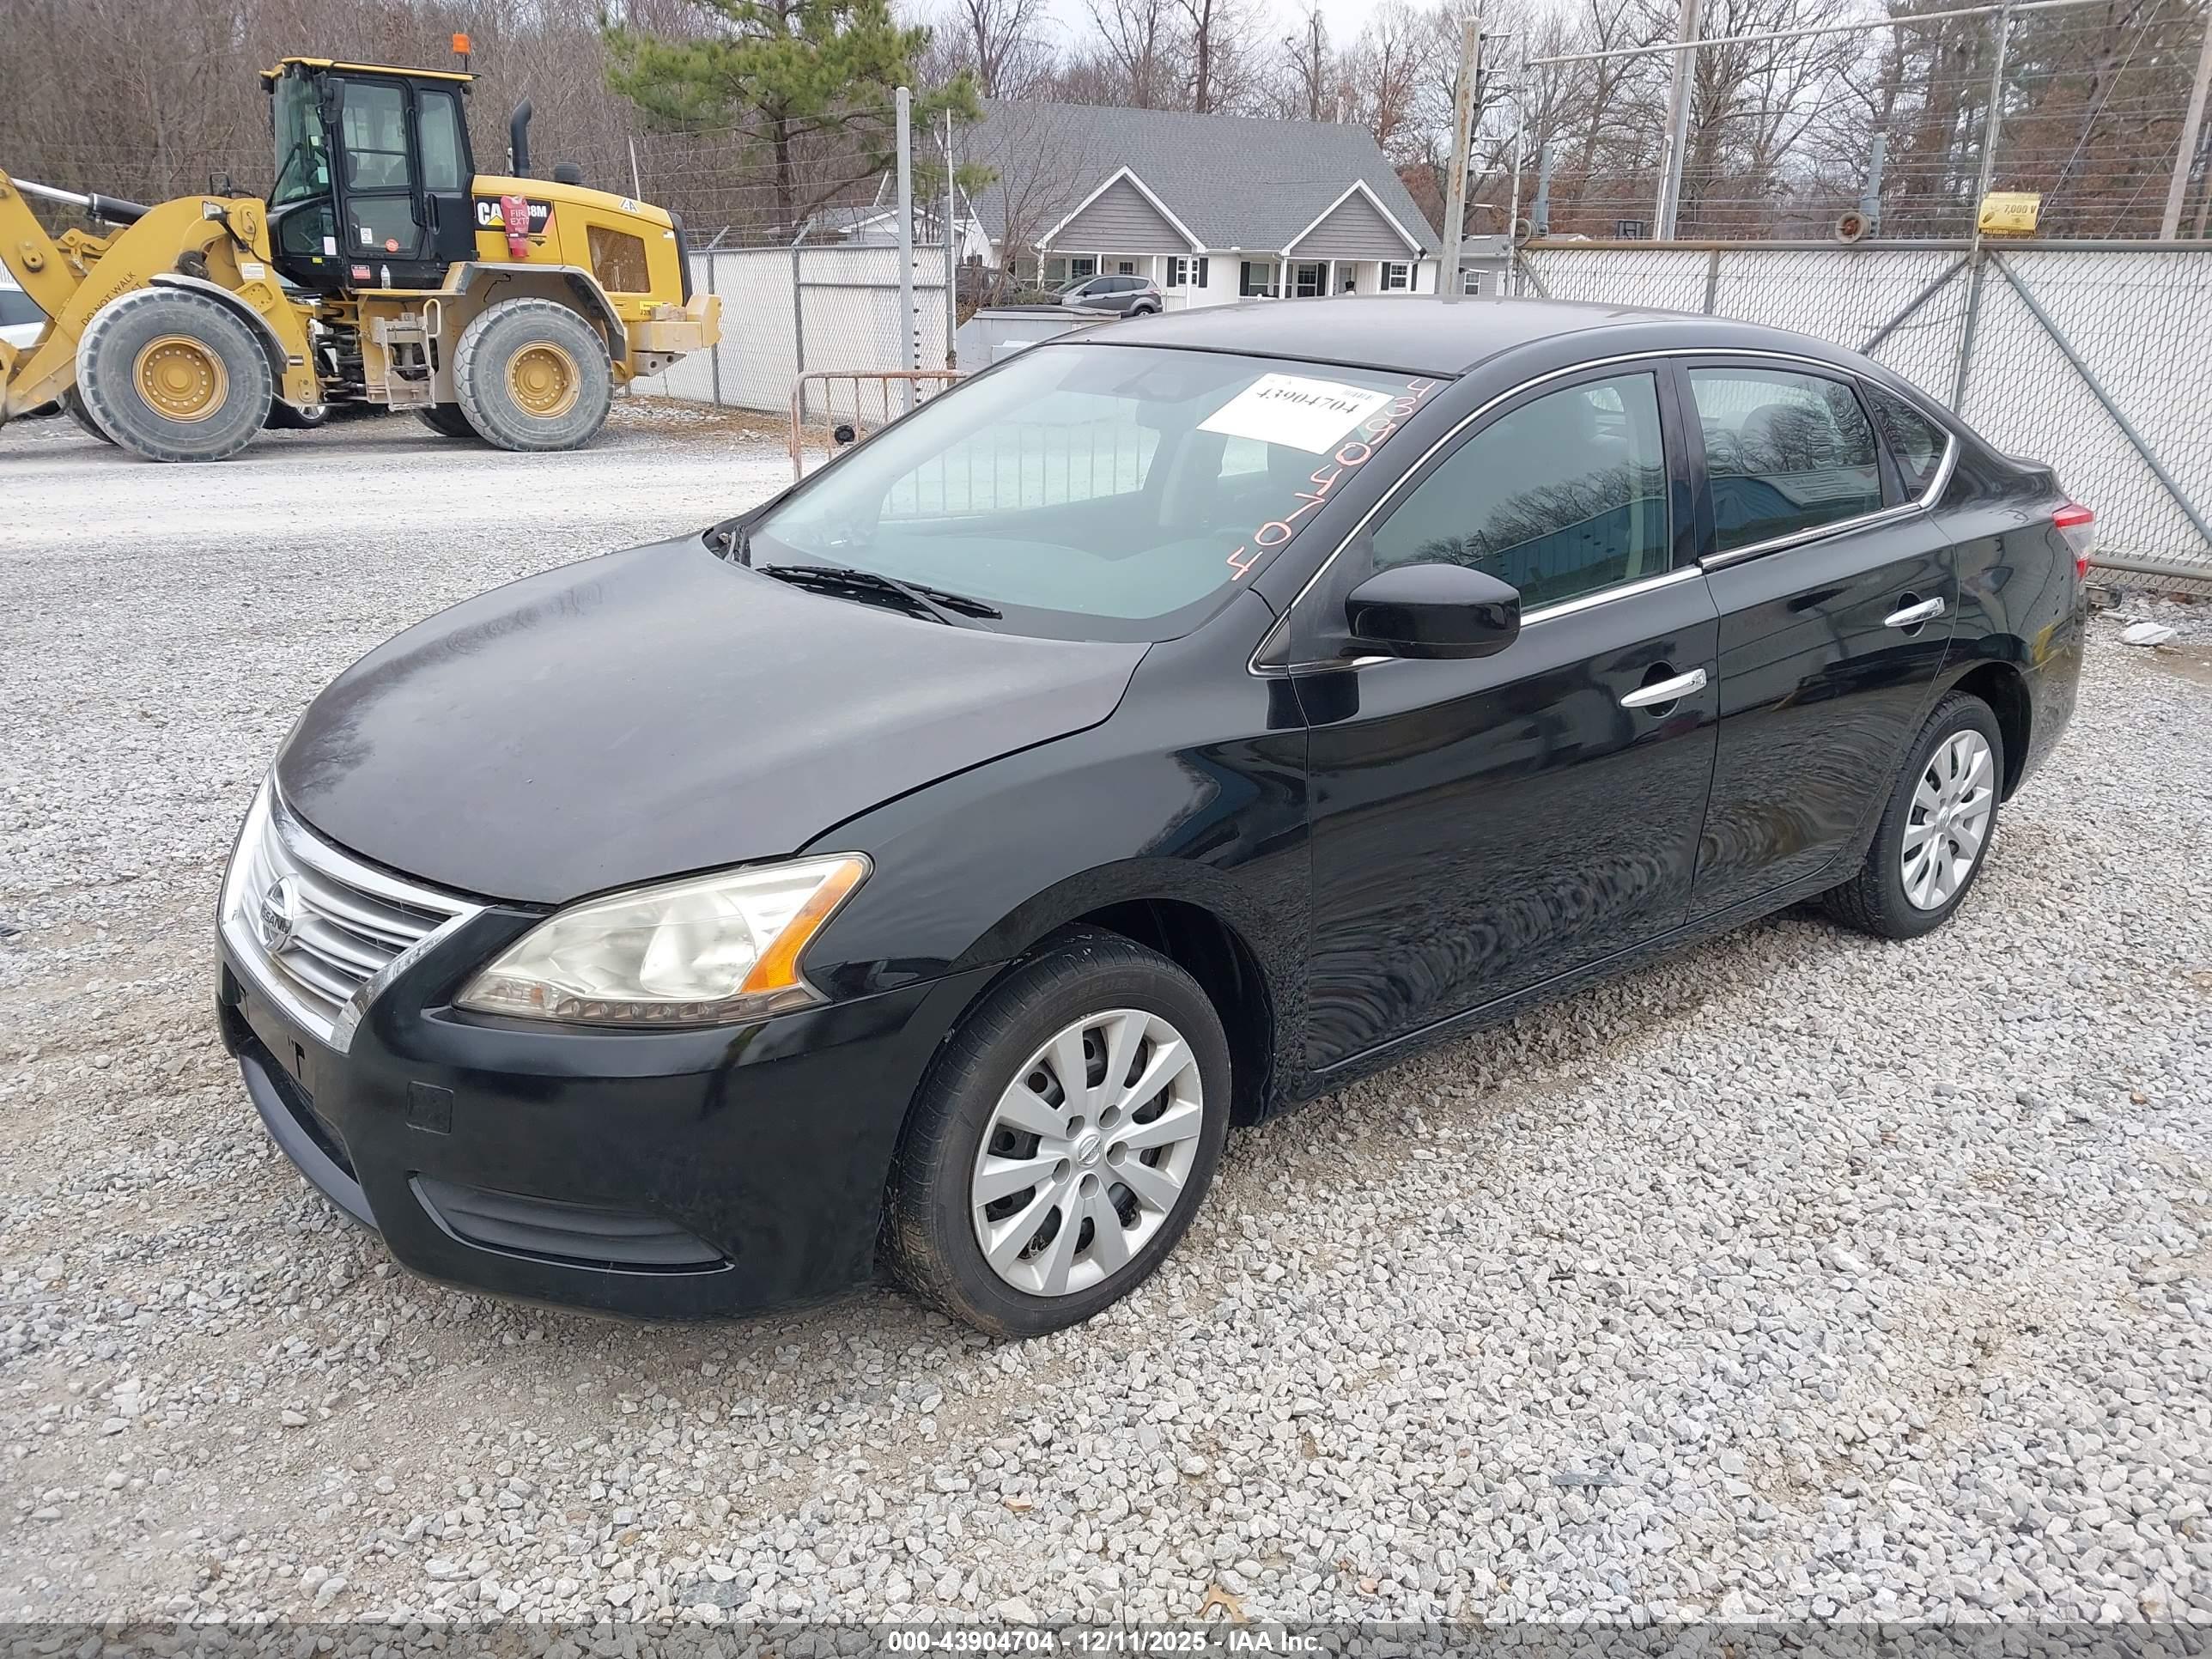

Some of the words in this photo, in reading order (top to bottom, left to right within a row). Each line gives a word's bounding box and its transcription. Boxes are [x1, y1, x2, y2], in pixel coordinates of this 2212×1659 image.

[477, 202, 505, 225] CA
[2003, 204, 2028, 216] 7,000
[2030, 205, 2037, 214] V
[81, 312, 94, 326] DO
[94, 294, 112, 313] NOT
[110, 270, 137, 295] WALK
[1256, 386, 1360, 415] 43904704
[1226, 378, 1437, 581] 43904704
